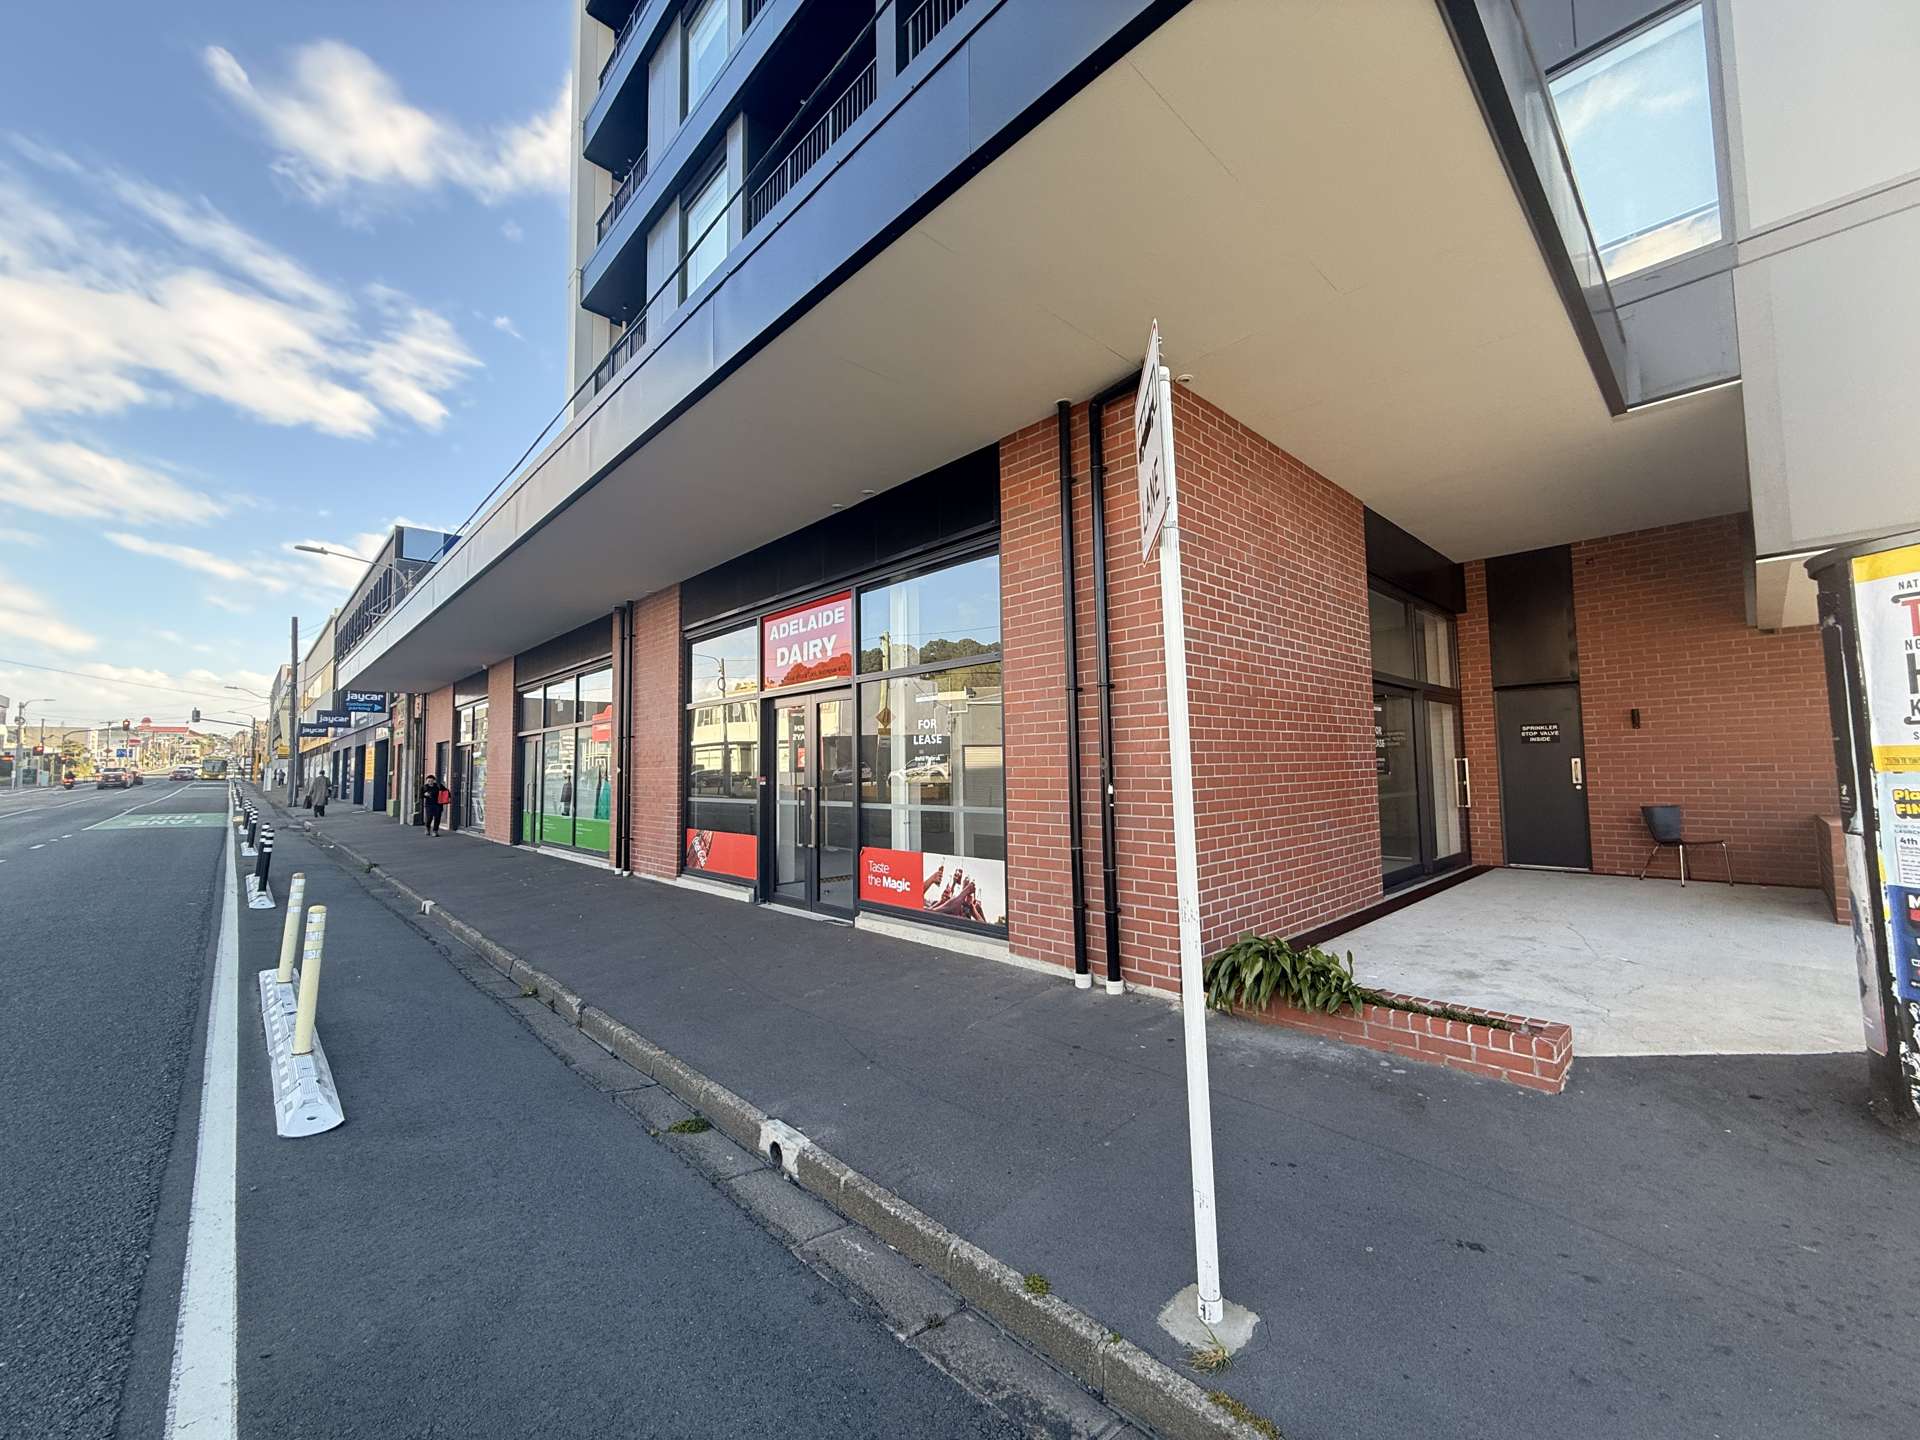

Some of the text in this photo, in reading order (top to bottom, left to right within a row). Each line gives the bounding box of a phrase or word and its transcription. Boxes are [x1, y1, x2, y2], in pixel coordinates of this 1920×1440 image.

[1142, 456, 1160, 535] LANE
[769, 606, 846, 641] ADELAIDE
[776, 634, 837, 667] DAIRY
[345, 691, 384, 702] jaycar
[319, 714, 350, 724] jaycar
[918, 719, 937, 730] FOR
[302, 726, 327, 734] jaycar
[913, 734, 943, 745] LEASE
[1900, 837, 1918, 847] 4th
[868, 860, 890, 874] Taste
[868, 874, 911, 893] the Magic
